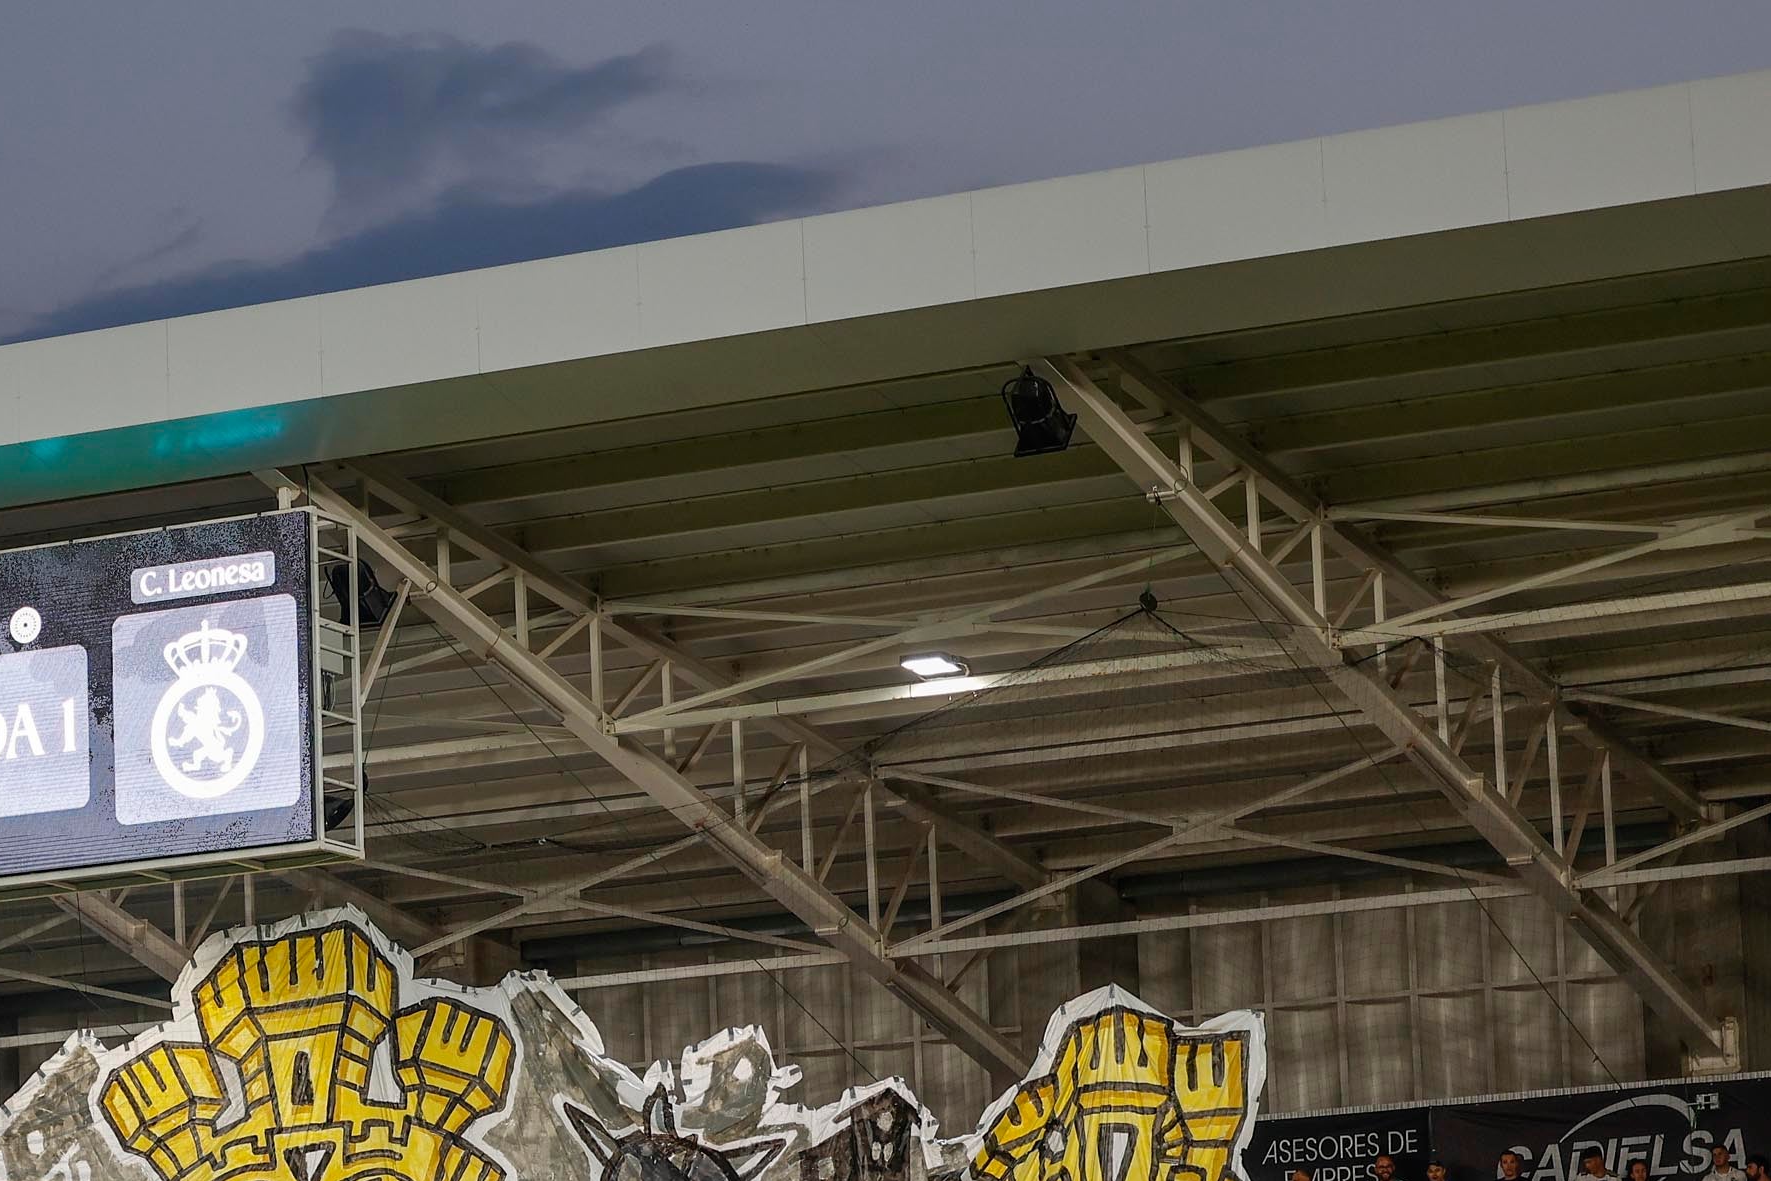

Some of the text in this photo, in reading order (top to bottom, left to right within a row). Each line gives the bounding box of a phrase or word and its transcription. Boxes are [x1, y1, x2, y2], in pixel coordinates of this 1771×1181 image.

[139, 561, 265, 597] C. Leonesa
[1261, 1129, 1417, 1165] ASESORES DE
